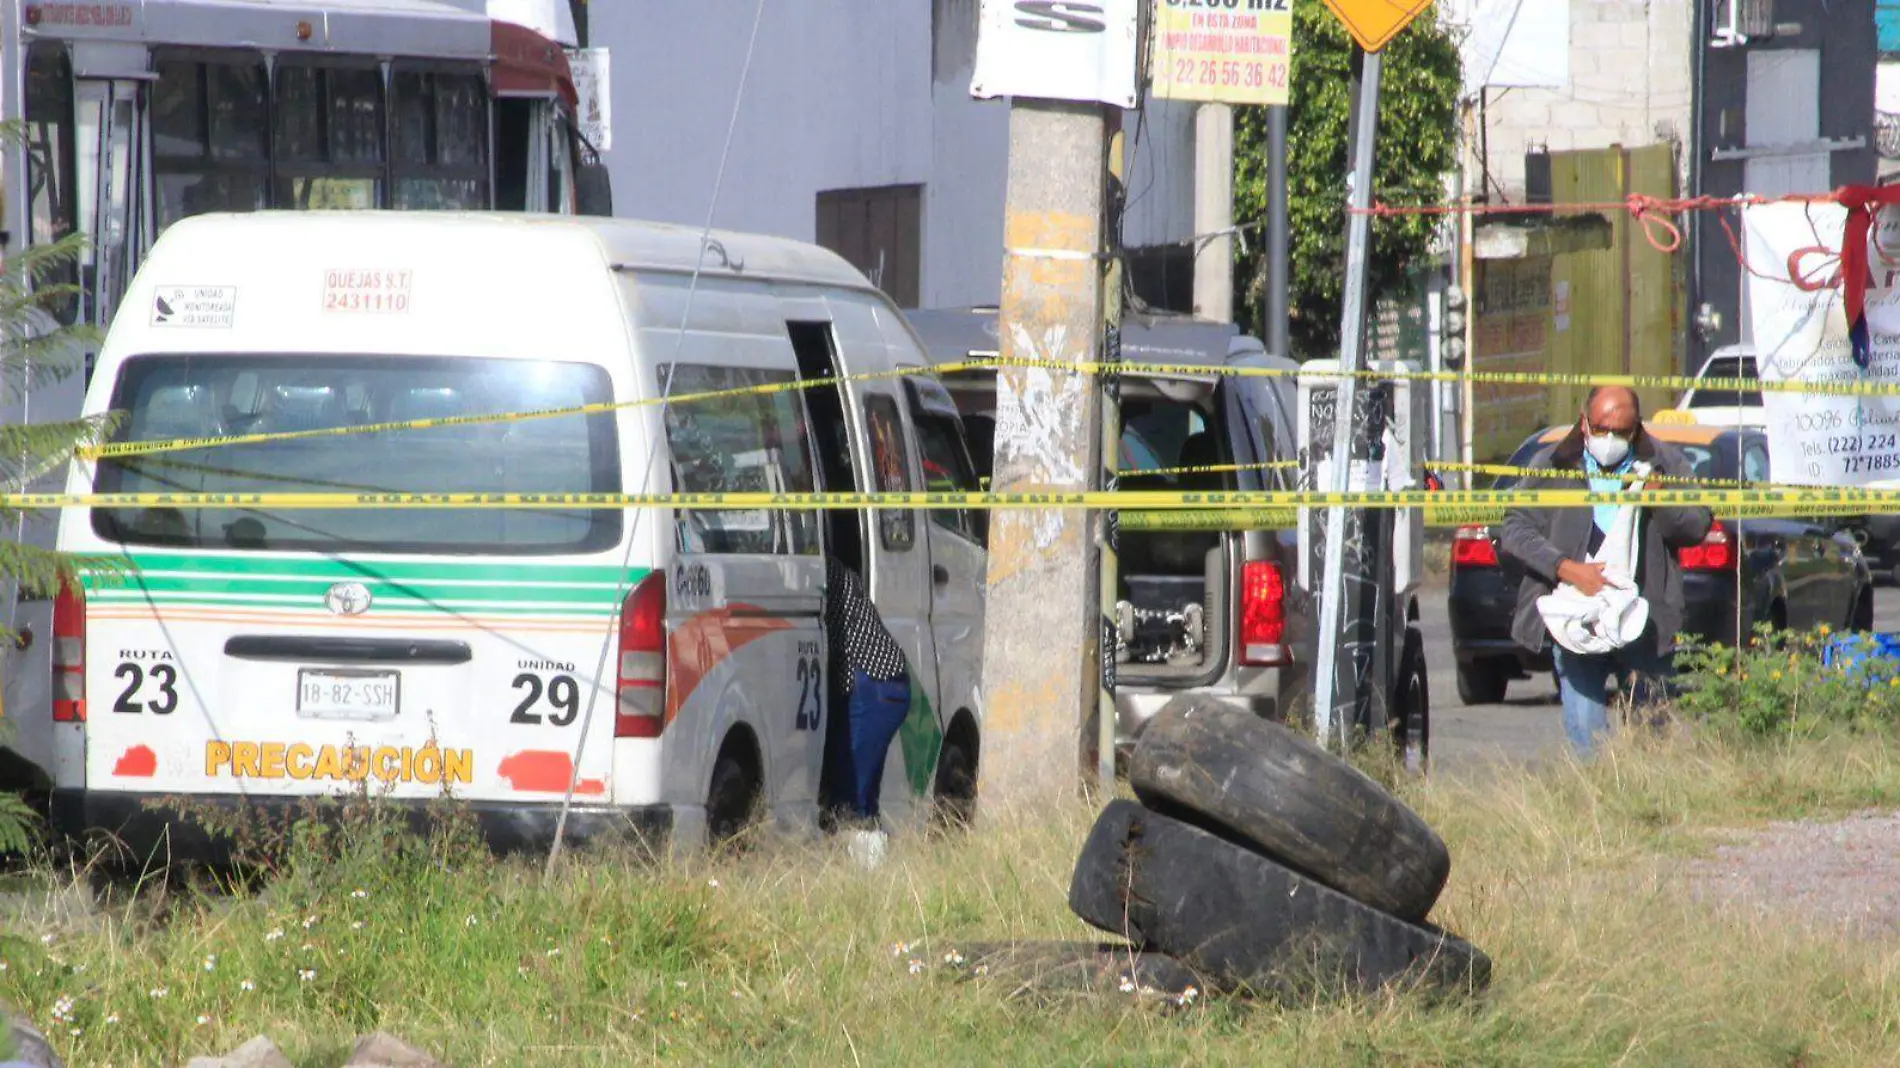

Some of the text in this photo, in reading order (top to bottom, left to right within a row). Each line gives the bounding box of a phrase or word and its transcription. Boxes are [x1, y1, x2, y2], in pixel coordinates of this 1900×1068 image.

[1231, 15, 1258, 29] ZONA
[1176, 59, 1287, 88] 22 26 56 36 42
[327, 272, 382, 289] QUEJAS
[194, 288, 224, 299] UNIDAD
[327, 292, 407, 311] 2431110
[1827, 434, 1863, 453] (222)
[1868, 434, 1896, 450] 224
[119, 649, 174, 660] RUTA
[517, 659, 576, 672] UNIDAD
[113, 662, 178, 715] 23
[796, 657, 822, 731] 23
[509, 672, 580, 727] 29
[205, 738, 473, 784] PRECAUCIÓN
